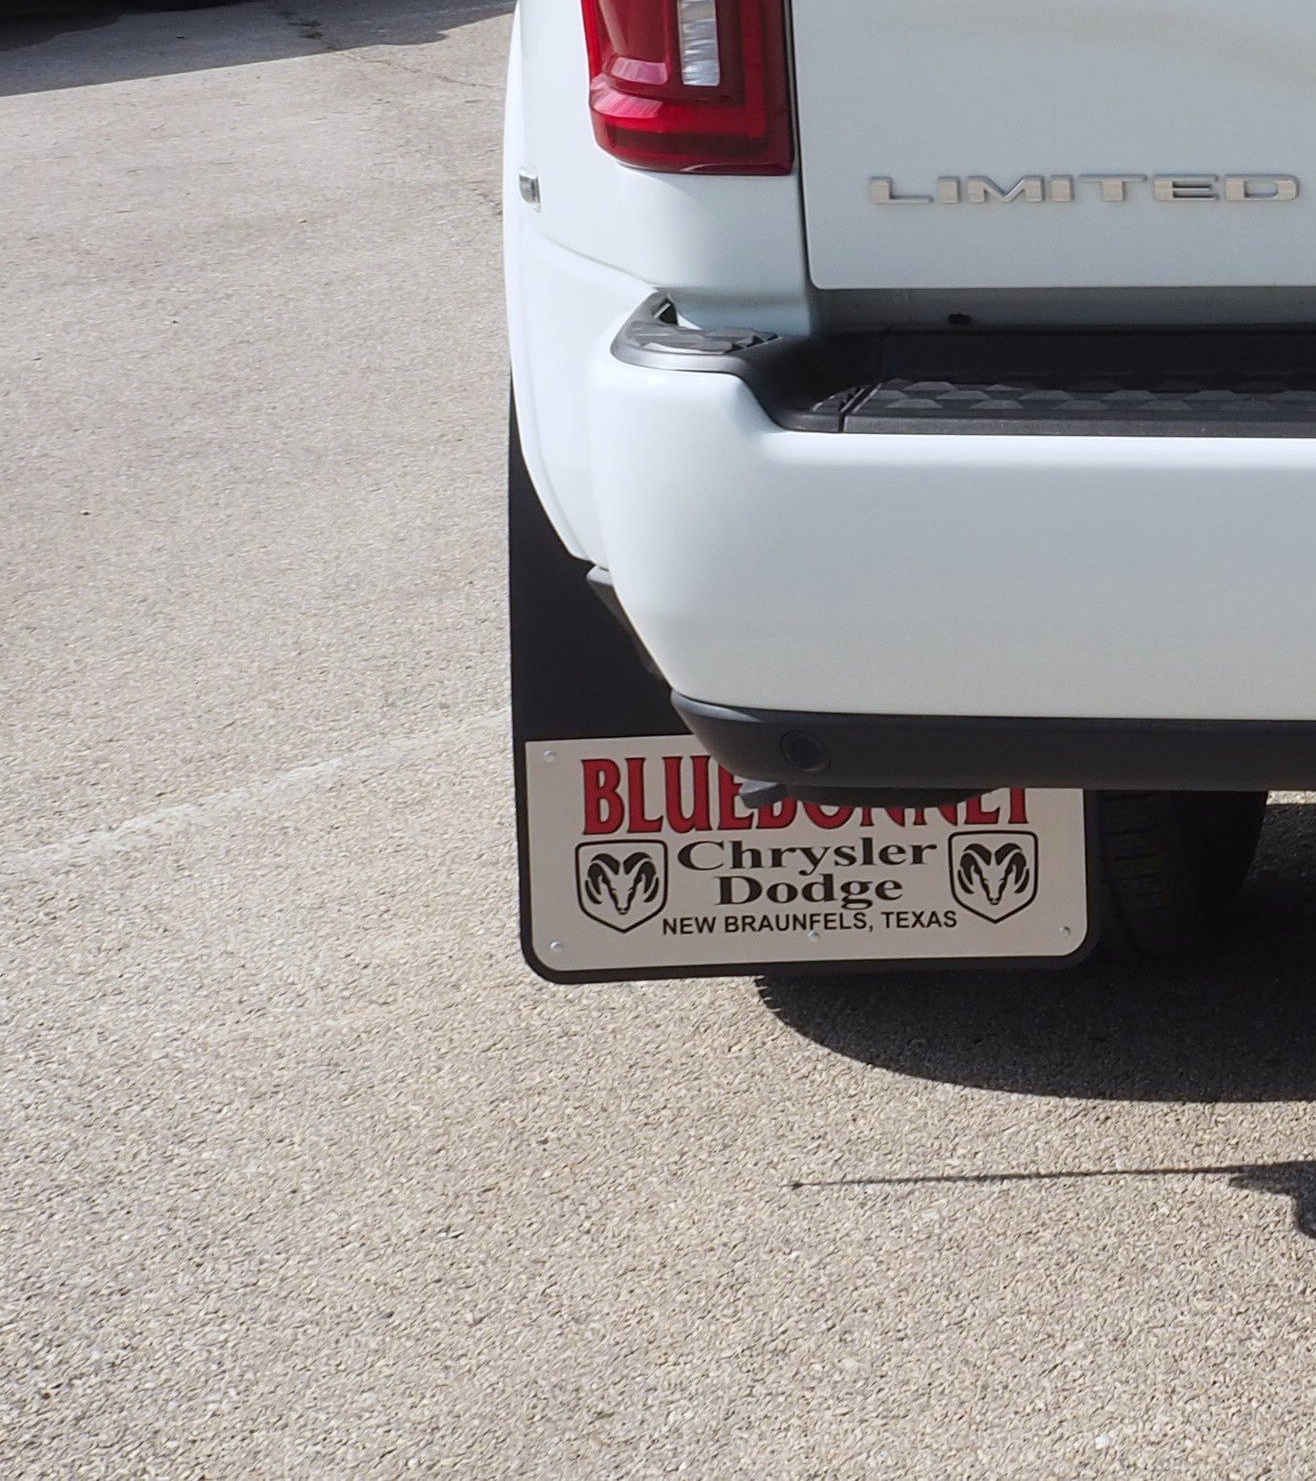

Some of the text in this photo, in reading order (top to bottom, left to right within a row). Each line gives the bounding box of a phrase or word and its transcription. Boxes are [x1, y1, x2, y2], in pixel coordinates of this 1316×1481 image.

[869, 173, 1300, 205] LIMITED
[676, 836, 938, 875] Chrysler
[713, 873, 904, 910] Dodge
[661, 910, 958, 936] NEW BRAUNFELS, TEXAS
